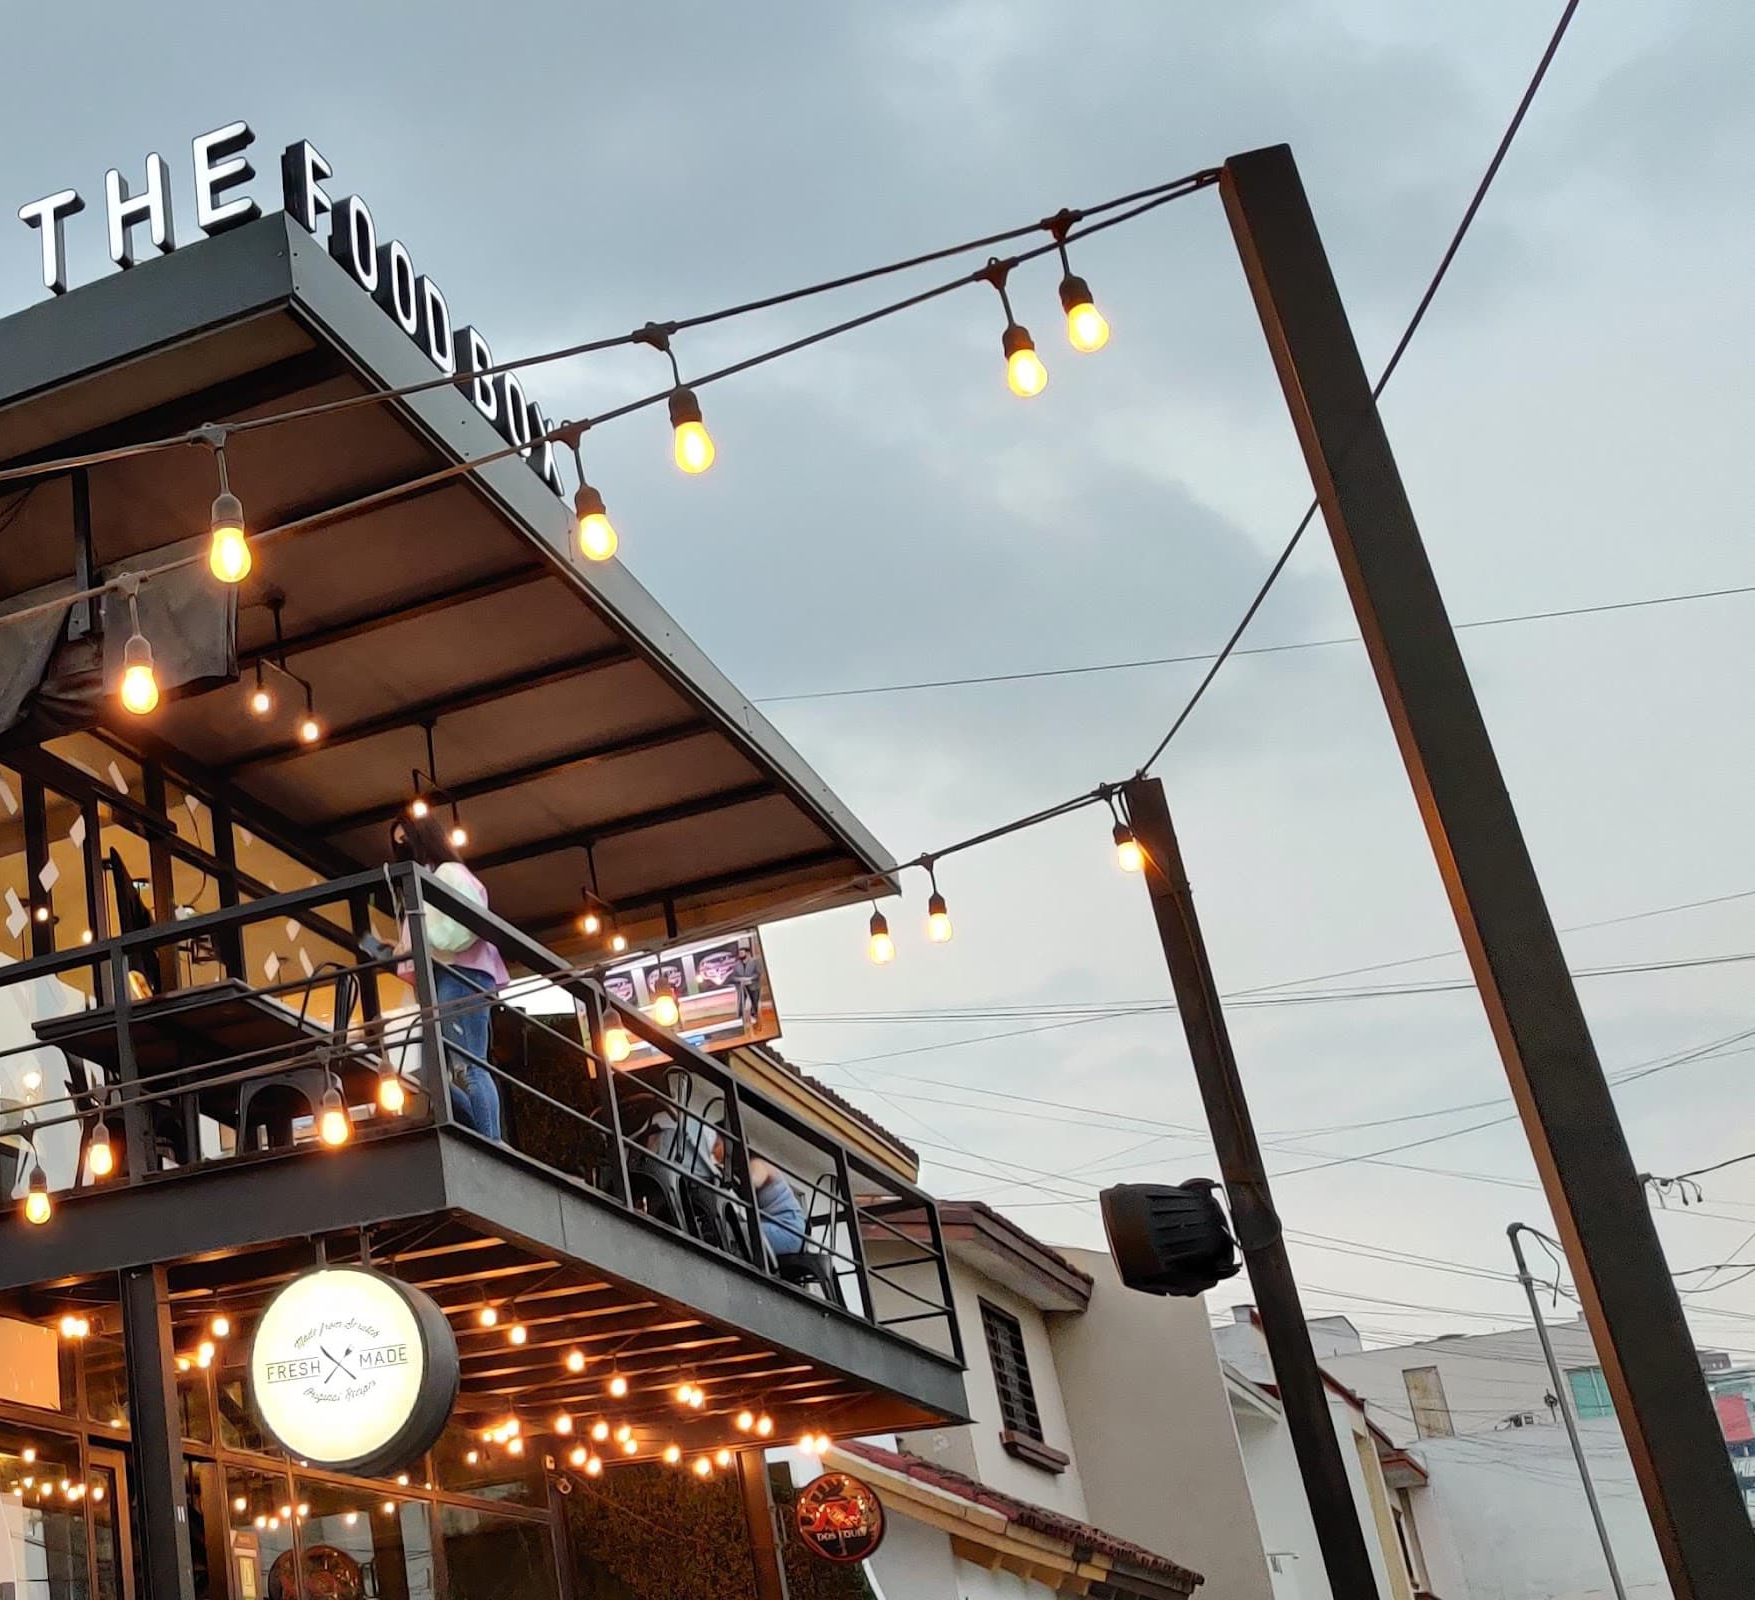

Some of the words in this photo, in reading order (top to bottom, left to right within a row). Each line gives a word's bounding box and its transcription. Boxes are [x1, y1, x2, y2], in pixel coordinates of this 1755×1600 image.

[17, 119, 263, 296] THE
[281, 138, 455, 375] FOOD
[453, 324, 565, 498] BOX
[266, 1359, 321, 1381] FRESH
[359, 1346, 408, 1367] MADE
